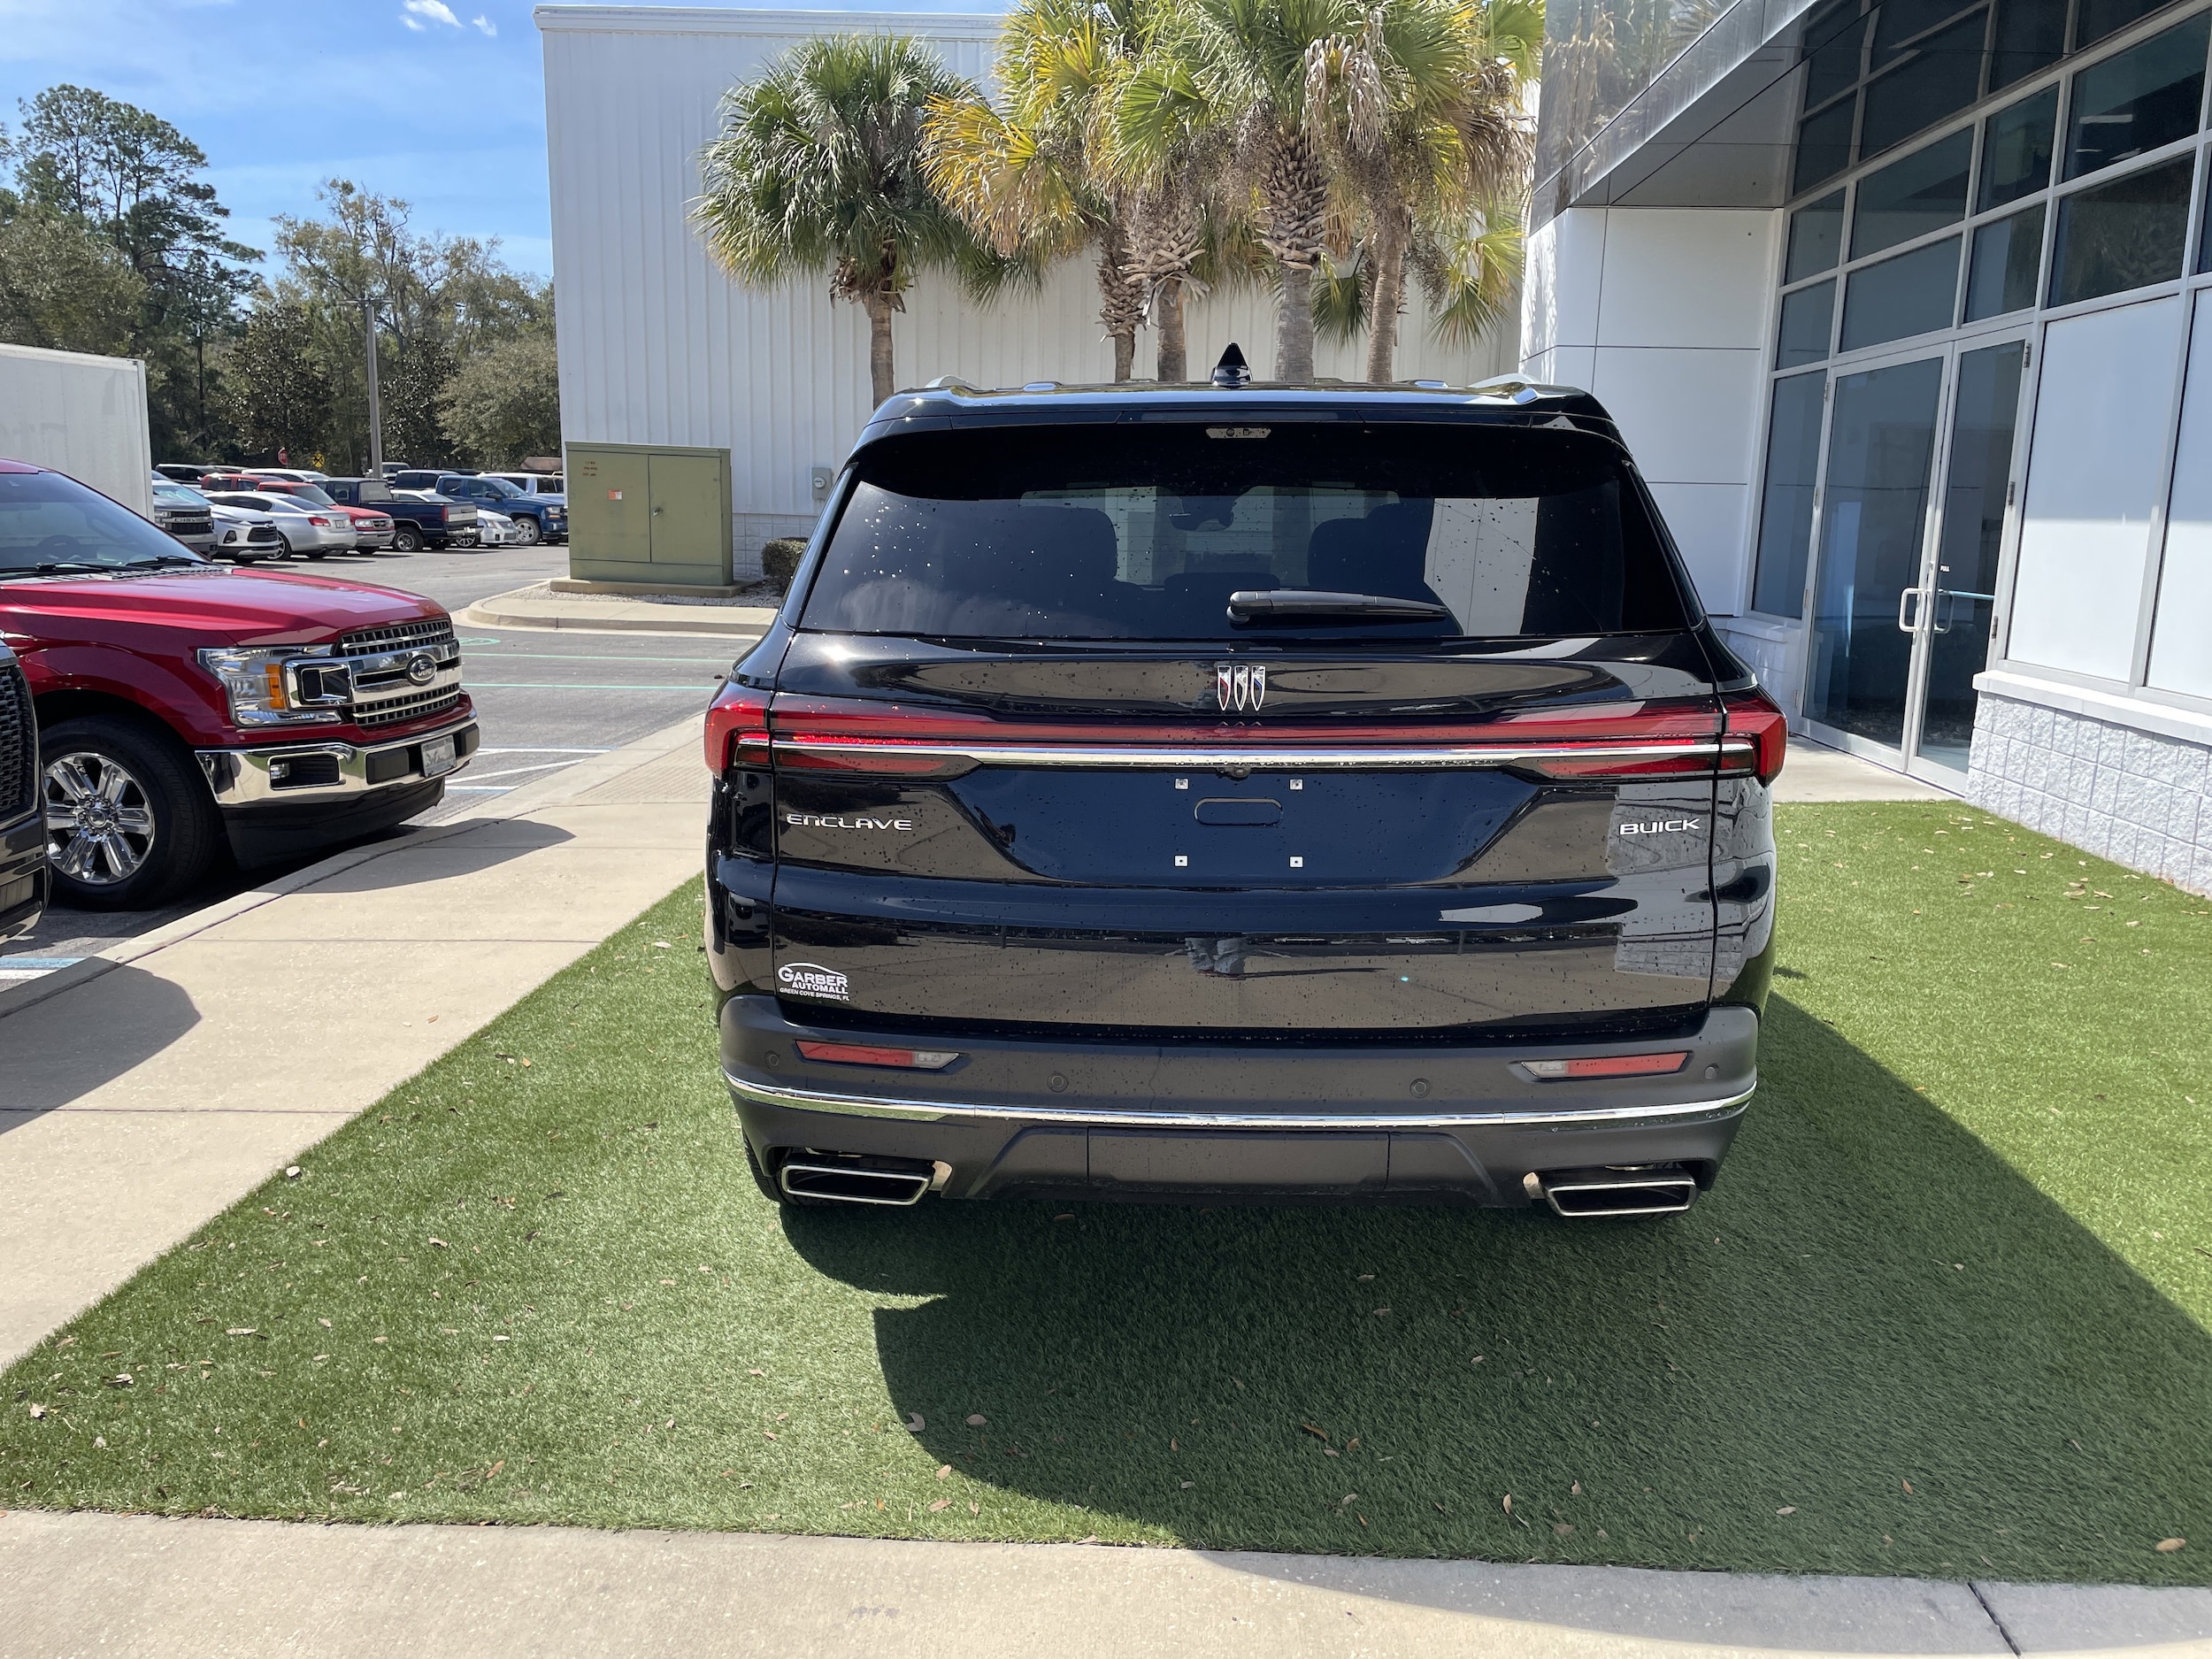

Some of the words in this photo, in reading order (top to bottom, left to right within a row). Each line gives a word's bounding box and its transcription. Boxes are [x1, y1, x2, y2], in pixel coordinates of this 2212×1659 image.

[786, 813, 912, 831] ENCLAVE
[1620, 818, 1701, 835] BUICK
[778, 966, 849, 987] GARBER
[792, 981, 849, 995] AUTOMALL
